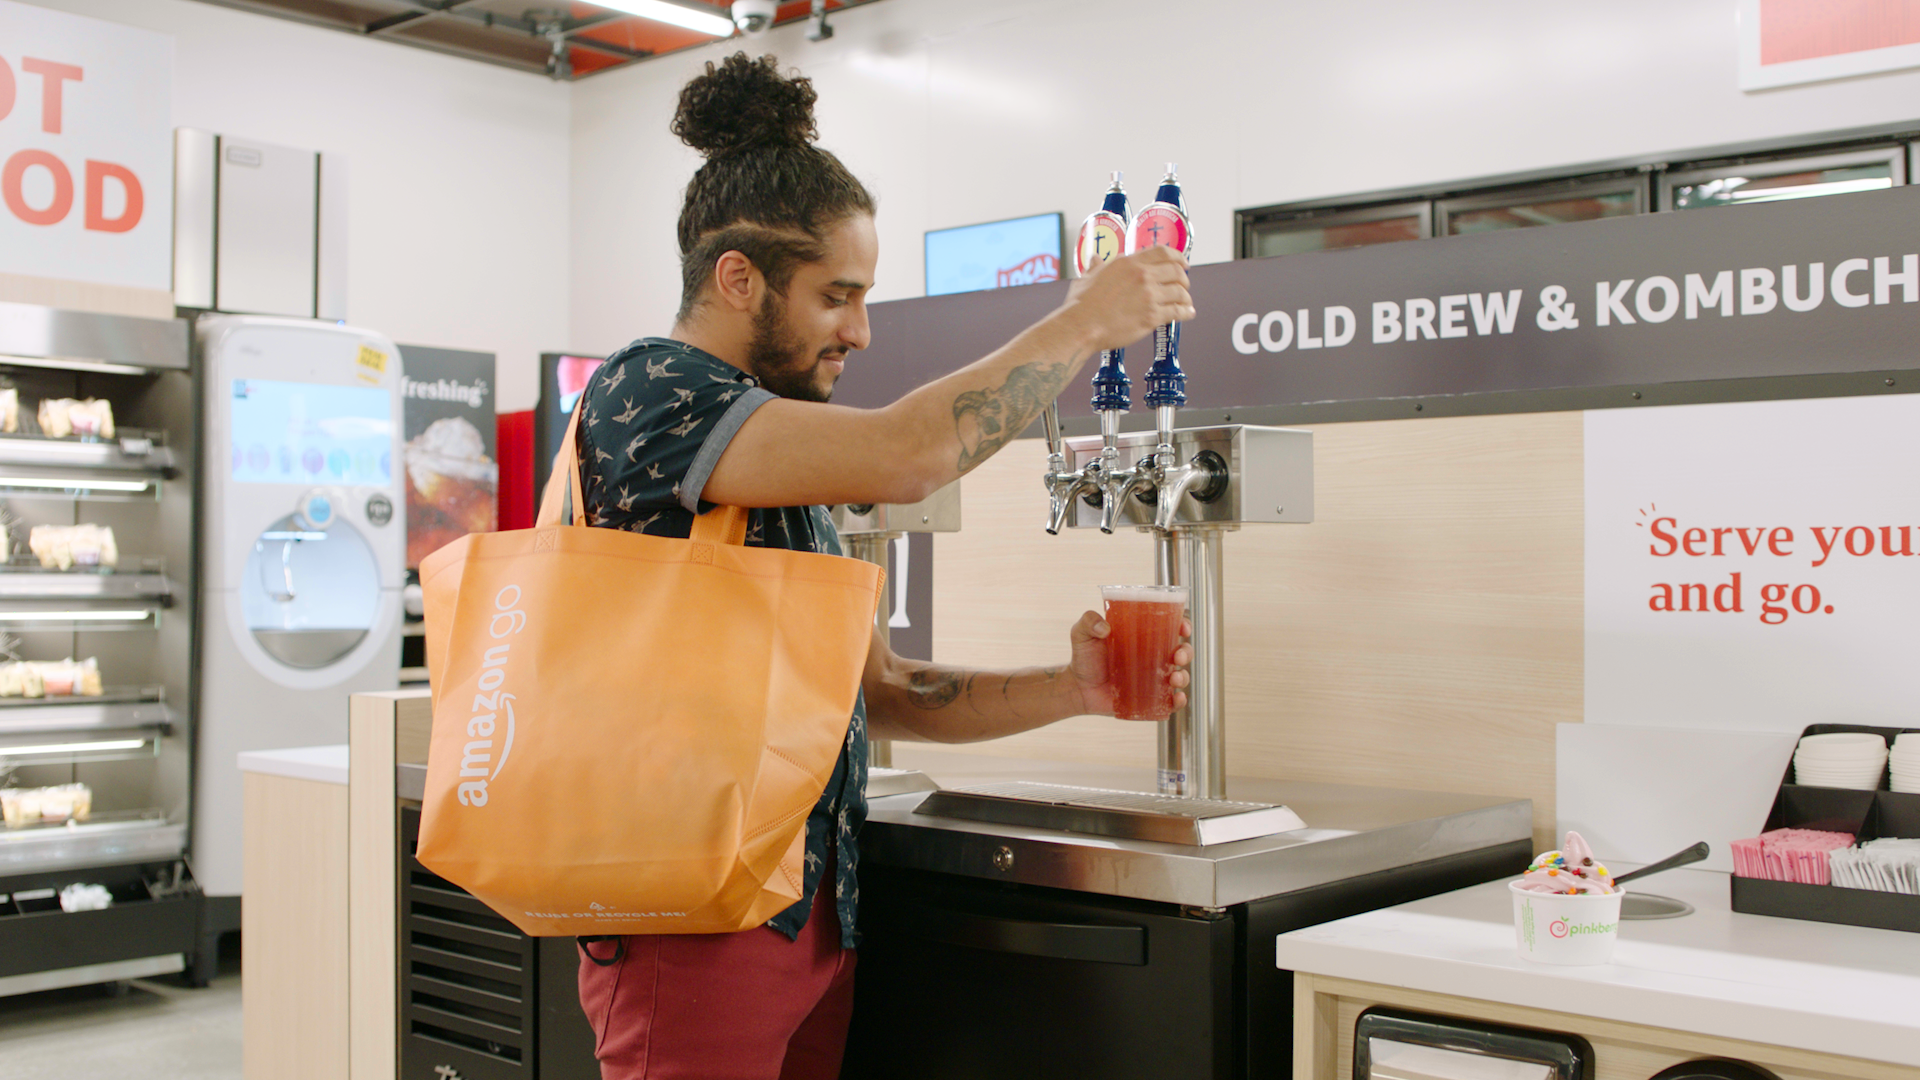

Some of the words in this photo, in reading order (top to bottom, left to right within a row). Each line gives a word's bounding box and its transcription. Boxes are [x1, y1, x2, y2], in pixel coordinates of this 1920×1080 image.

[0, 54, 84, 135] T
[1231, 305, 1357, 355] COLD
[1371, 289, 1523, 344] BREW
[1535, 284, 1580, 332] &
[1595, 253, 1920, 327] KOMBUCH
[1649, 516, 1795, 557] Serve
[1648, 571, 1745, 613] and
[1759, 583, 1835, 625] go.
[457, 643, 511, 808] amazon
[489, 584, 527, 639] go
